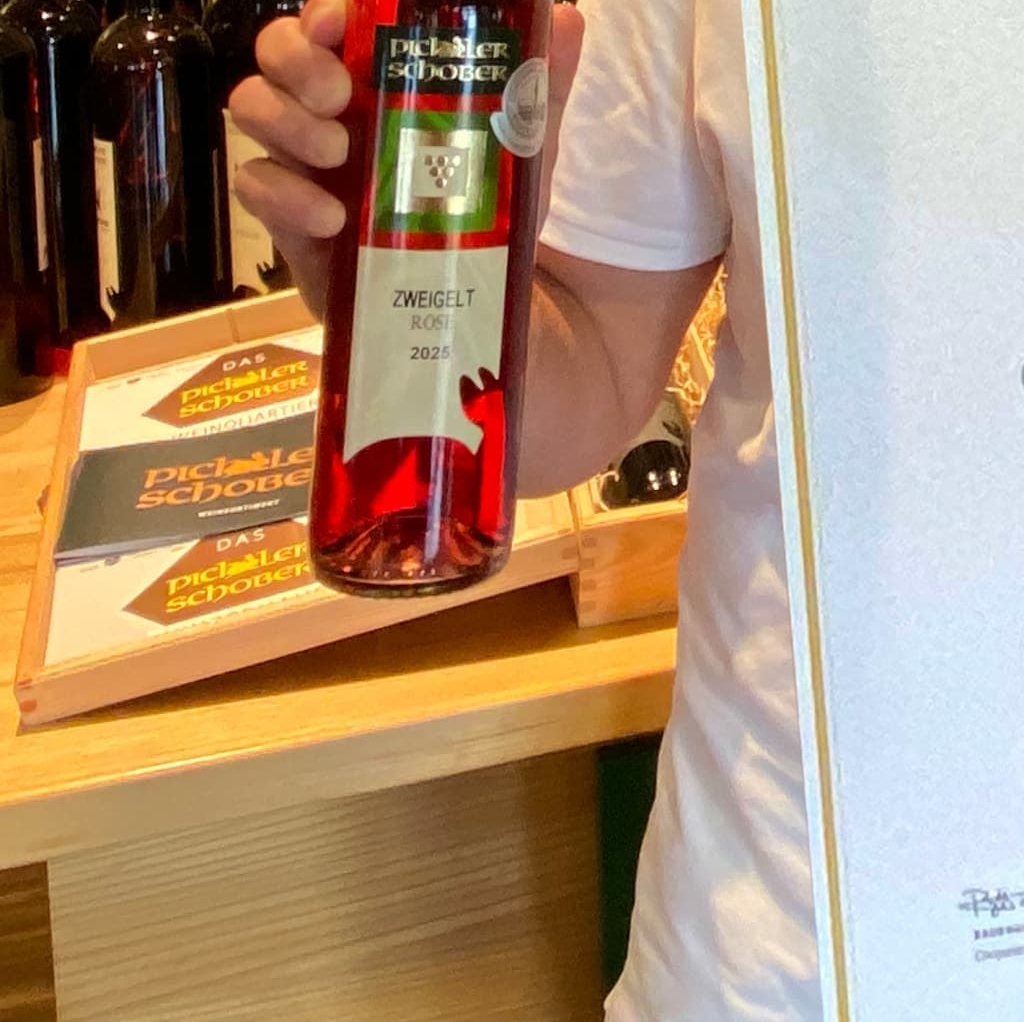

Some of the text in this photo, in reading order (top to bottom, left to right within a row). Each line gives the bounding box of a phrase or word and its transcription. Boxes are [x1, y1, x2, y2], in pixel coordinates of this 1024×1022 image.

[392, 289, 475, 308] ZWEIGELT
[223, 352, 266, 372] DAS
[410, 346, 450, 360] 2025
[216, 528, 266, 553] DAS
